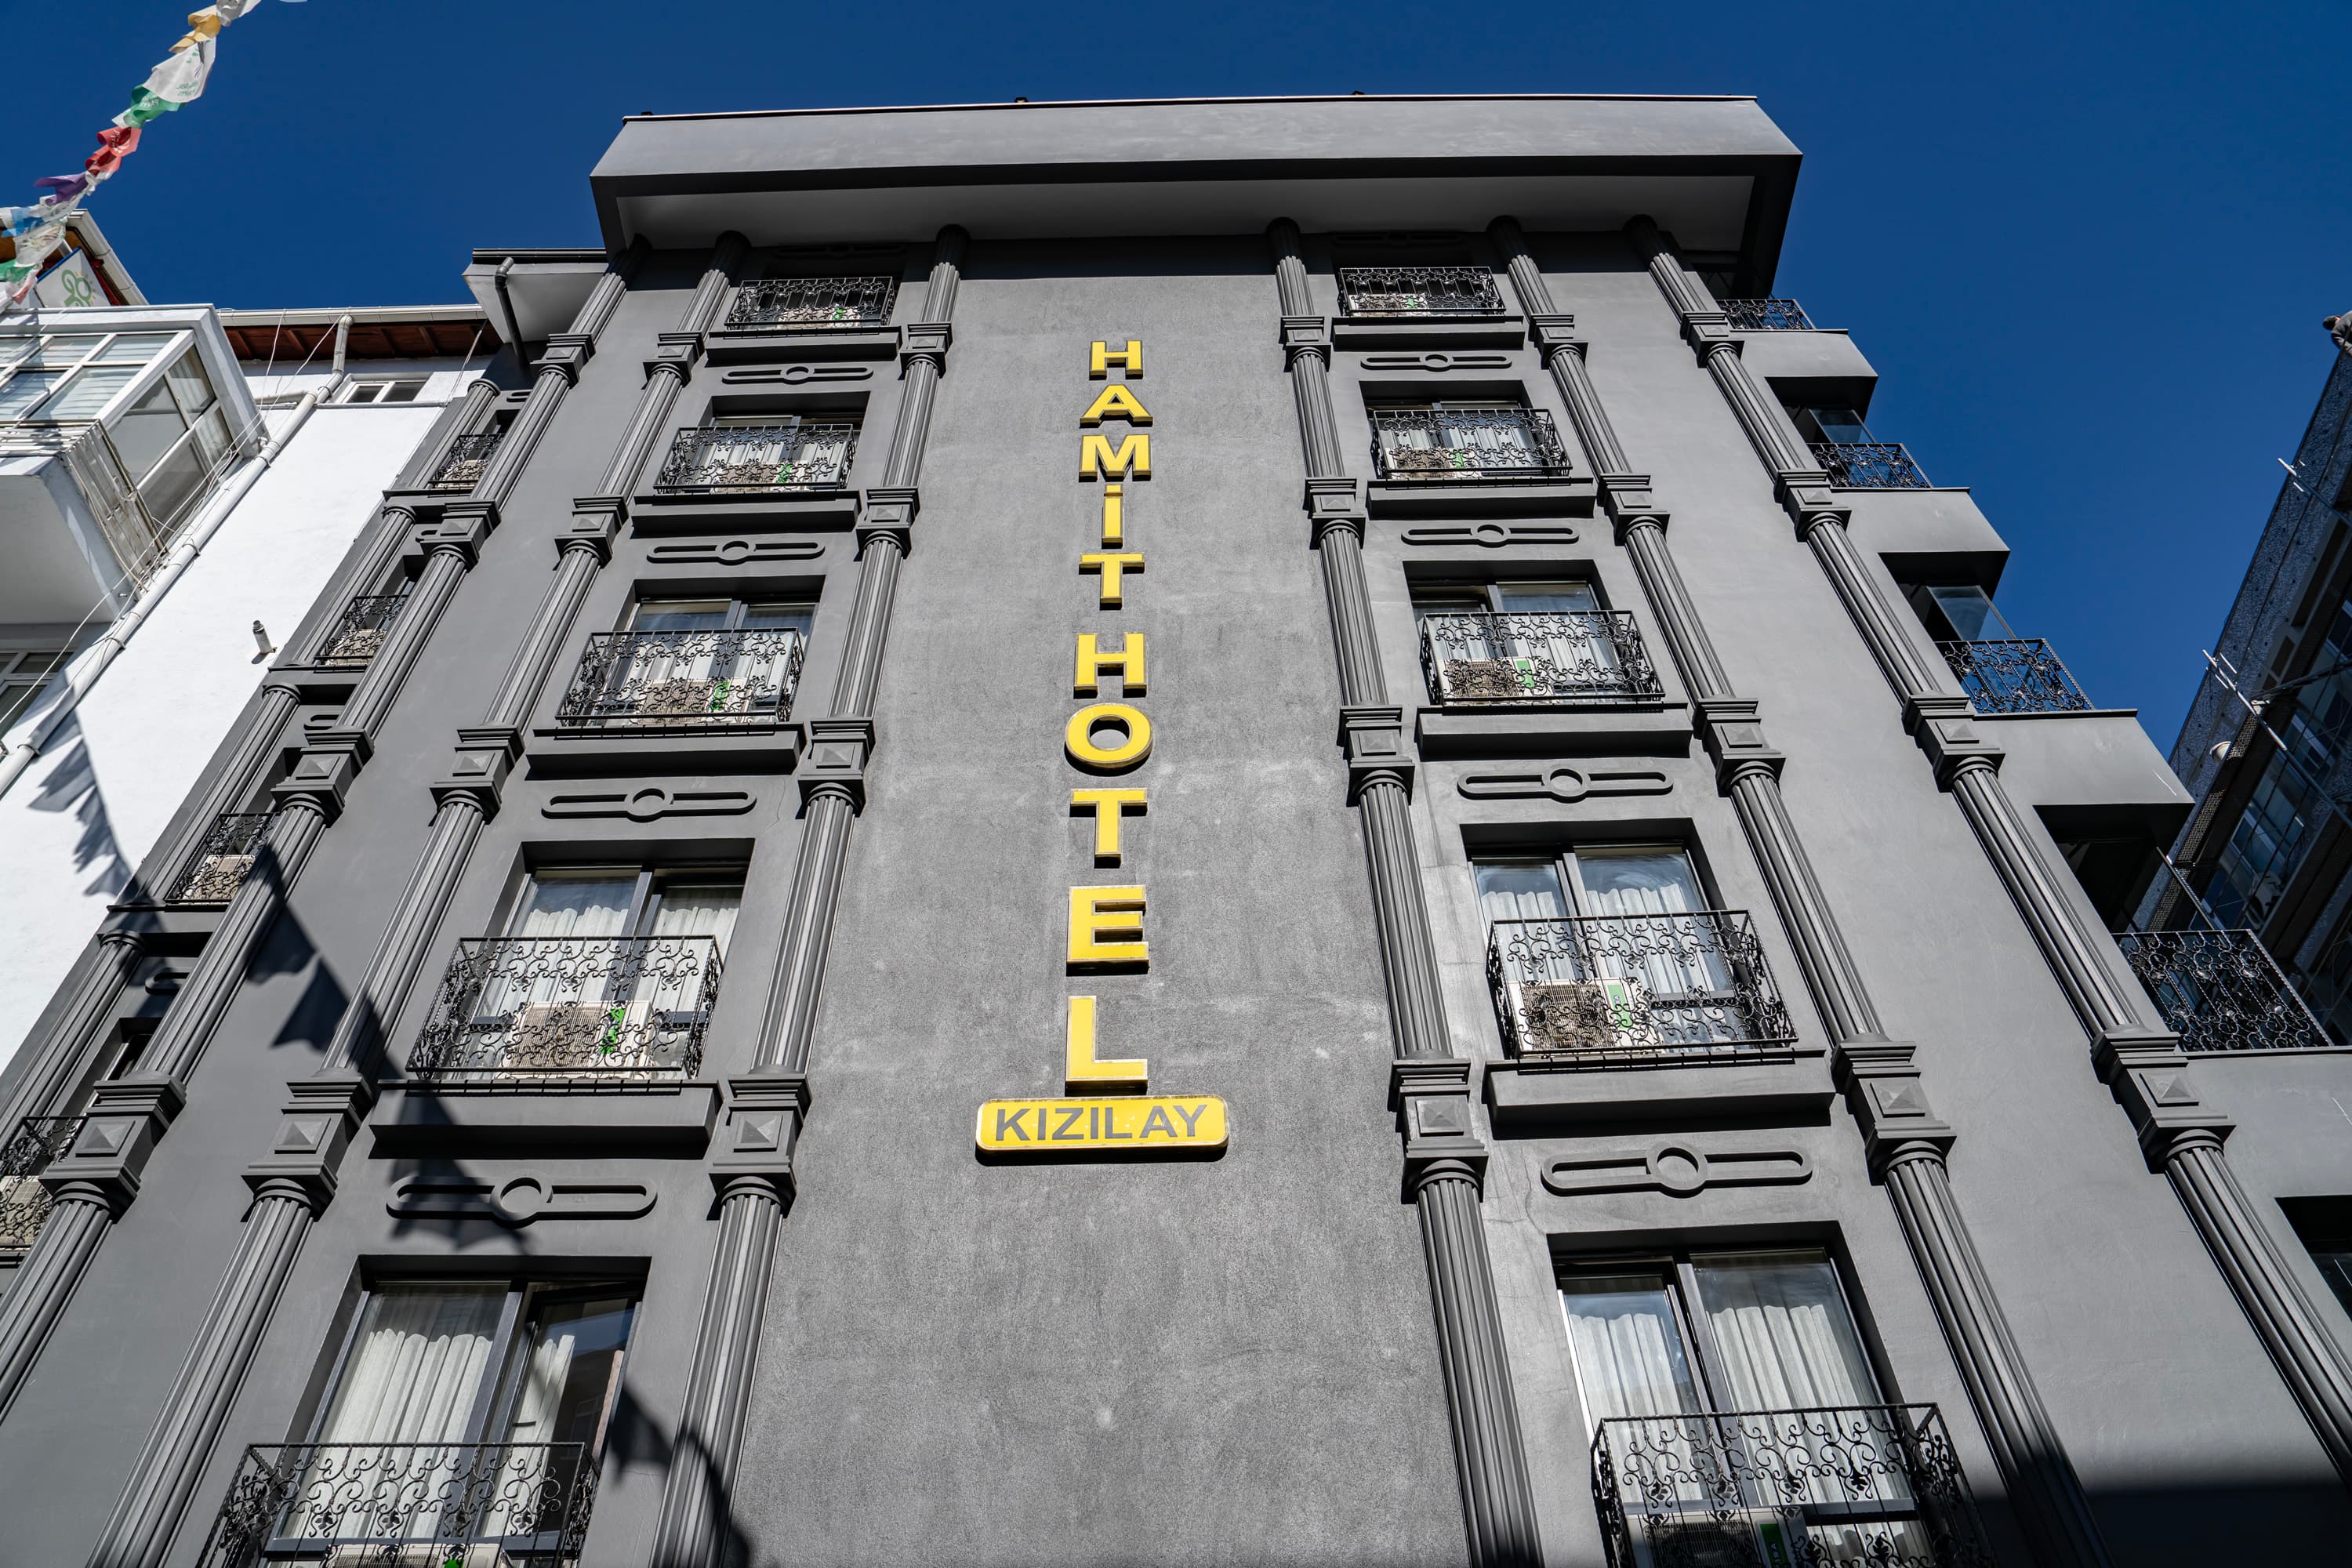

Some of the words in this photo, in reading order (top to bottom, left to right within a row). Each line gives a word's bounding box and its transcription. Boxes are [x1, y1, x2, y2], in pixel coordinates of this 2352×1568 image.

[1079, 339, 1153, 603] HAMİT
[1065, 632, 1154, 1082] HOTEL
[994, 1103, 1208, 1142] KIZILAY
